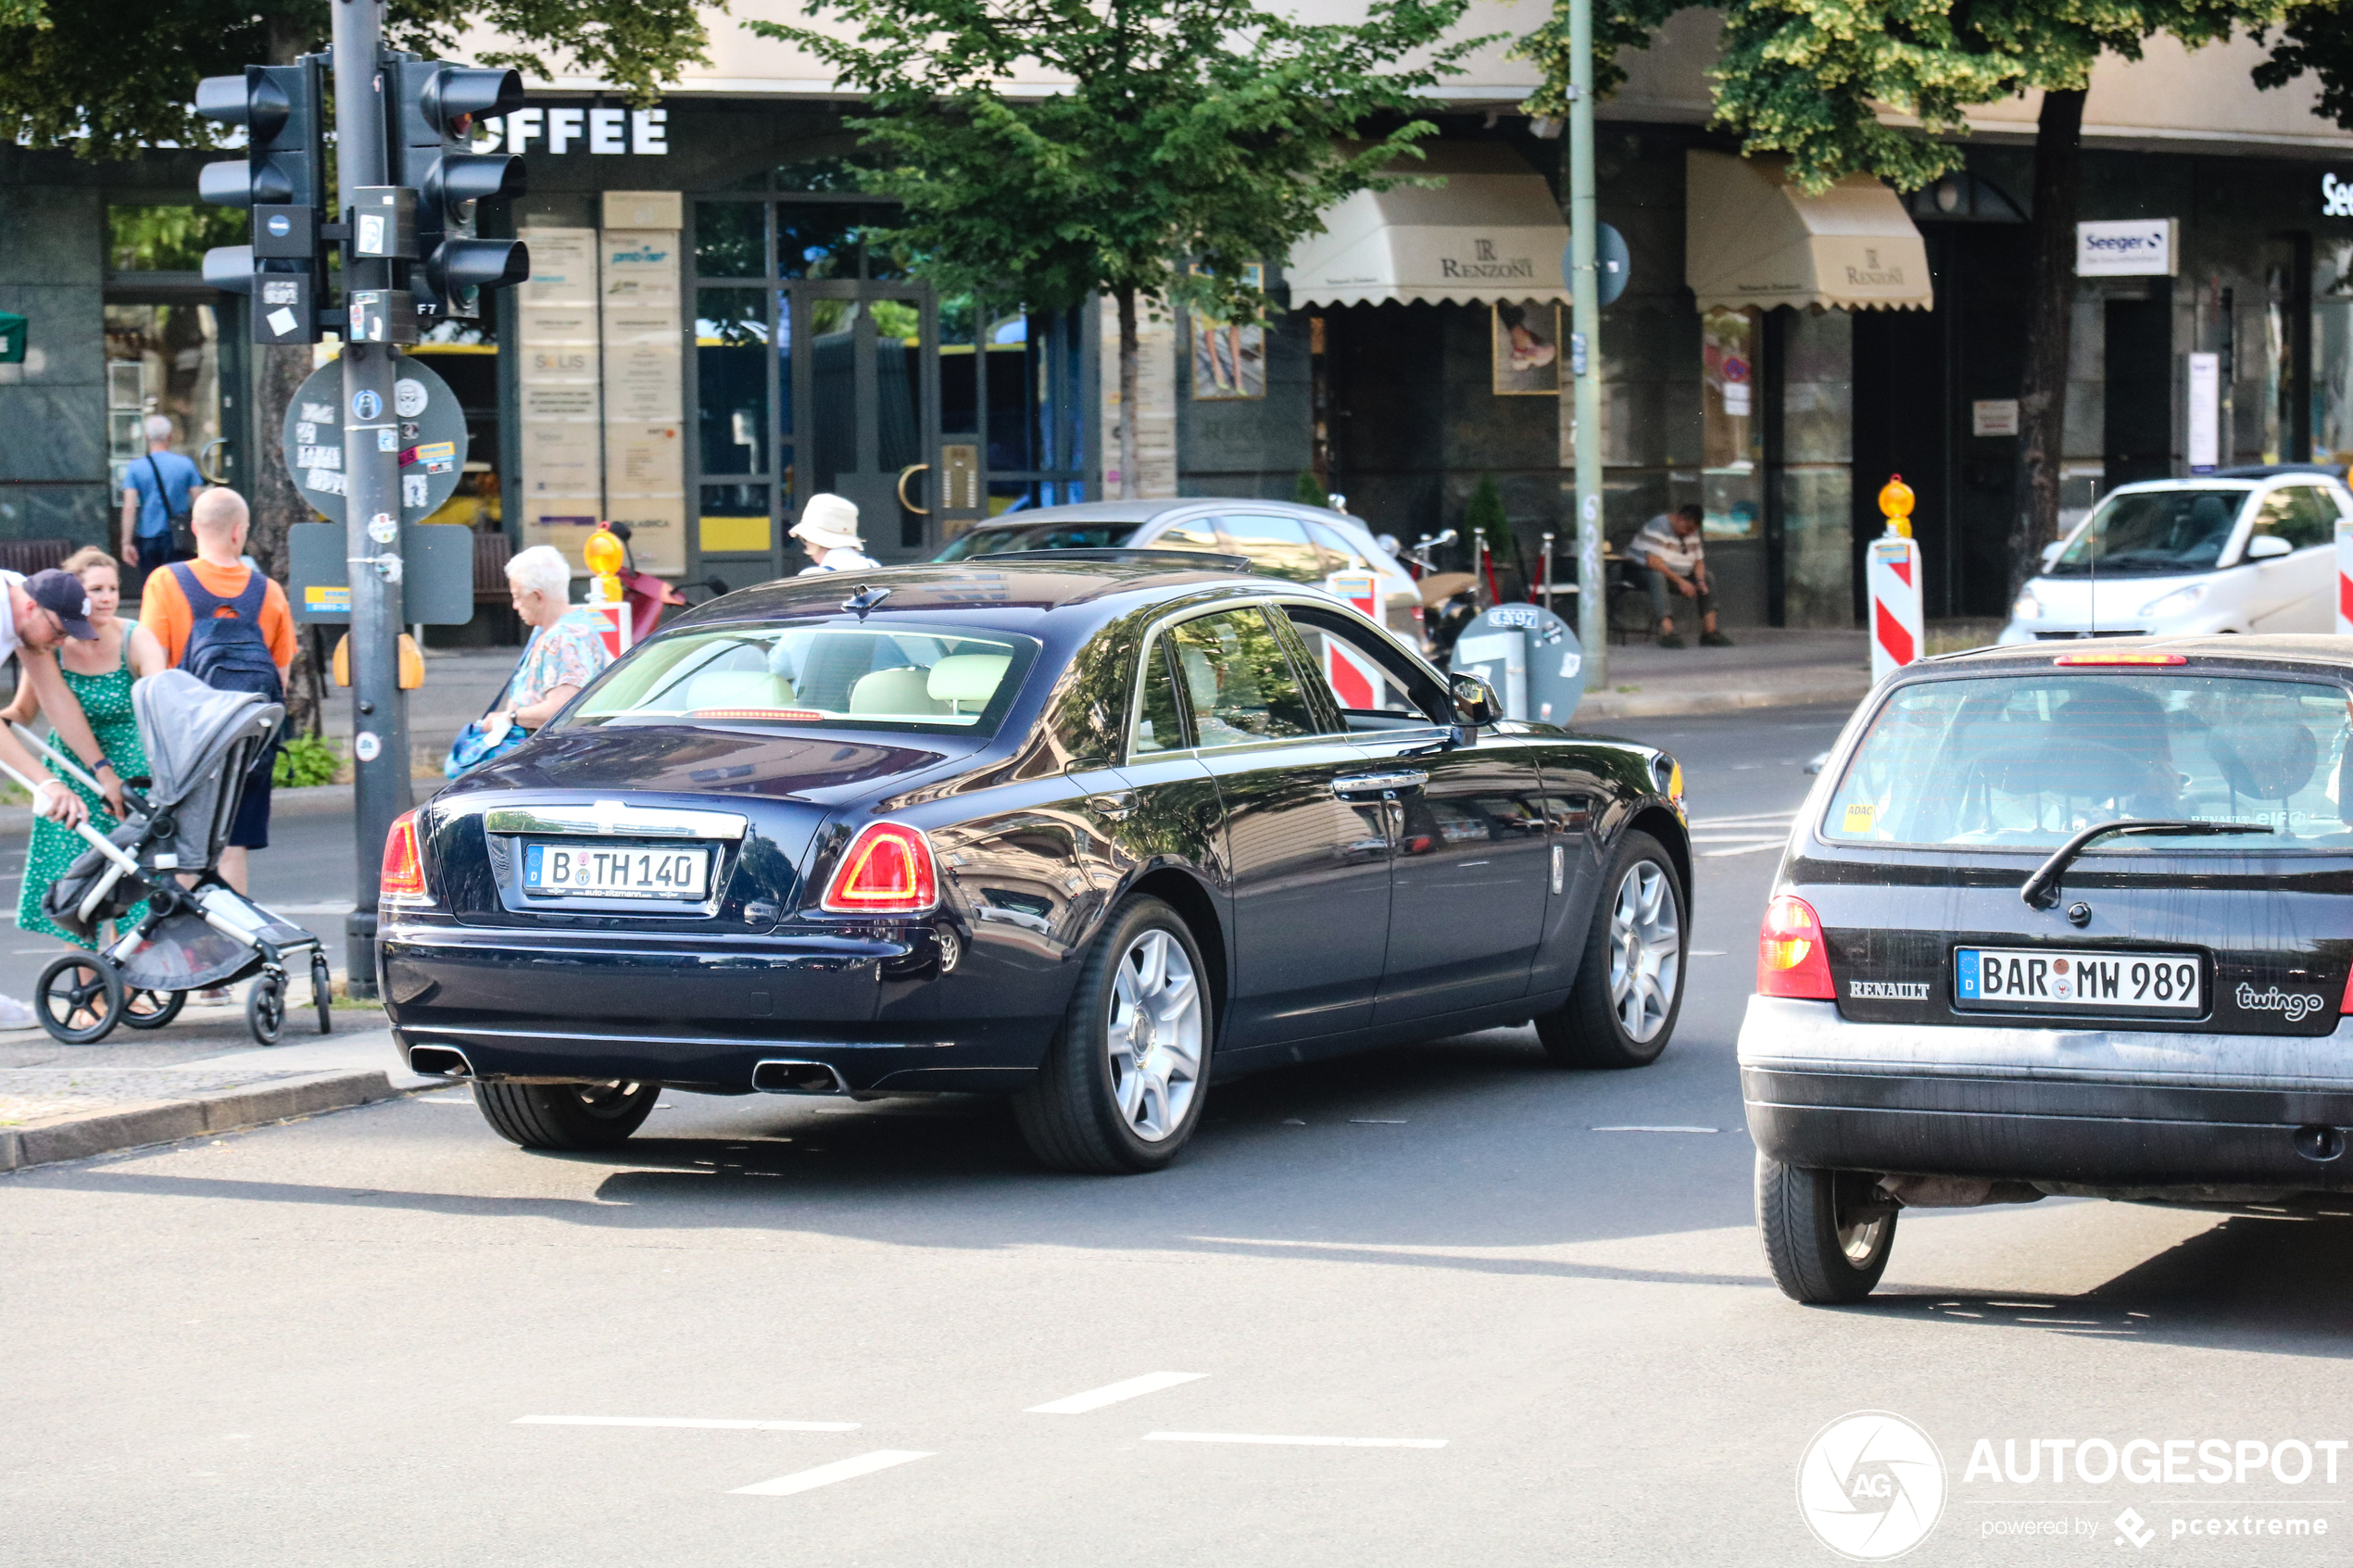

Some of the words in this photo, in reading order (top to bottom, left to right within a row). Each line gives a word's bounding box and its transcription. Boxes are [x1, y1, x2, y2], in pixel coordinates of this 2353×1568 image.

[471, 107, 669, 156] OFFEE
[2085, 233, 2144, 253] Seeger
[1441, 258, 1533, 278] RENZONI
[417, 304, 437, 315] F7
[1847, 806, 1873, 815] ADAC
[2256, 811, 2287, 826] elf
[530, 872, 537, 882] D
[552, 852, 571, 884] B
[593, 853, 630, 885] TH
[636, 855, 692, 887] 140
[1965, 979, 1974, 991] D
[1982, 956, 2047, 997] BAR
[2077, 960, 2120, 999] MW
[2131, 962, 2196, 1001] 989
[1850, 981, 1930, 999] RENAULT
[2235, 982, 2324, 1022] twingo
